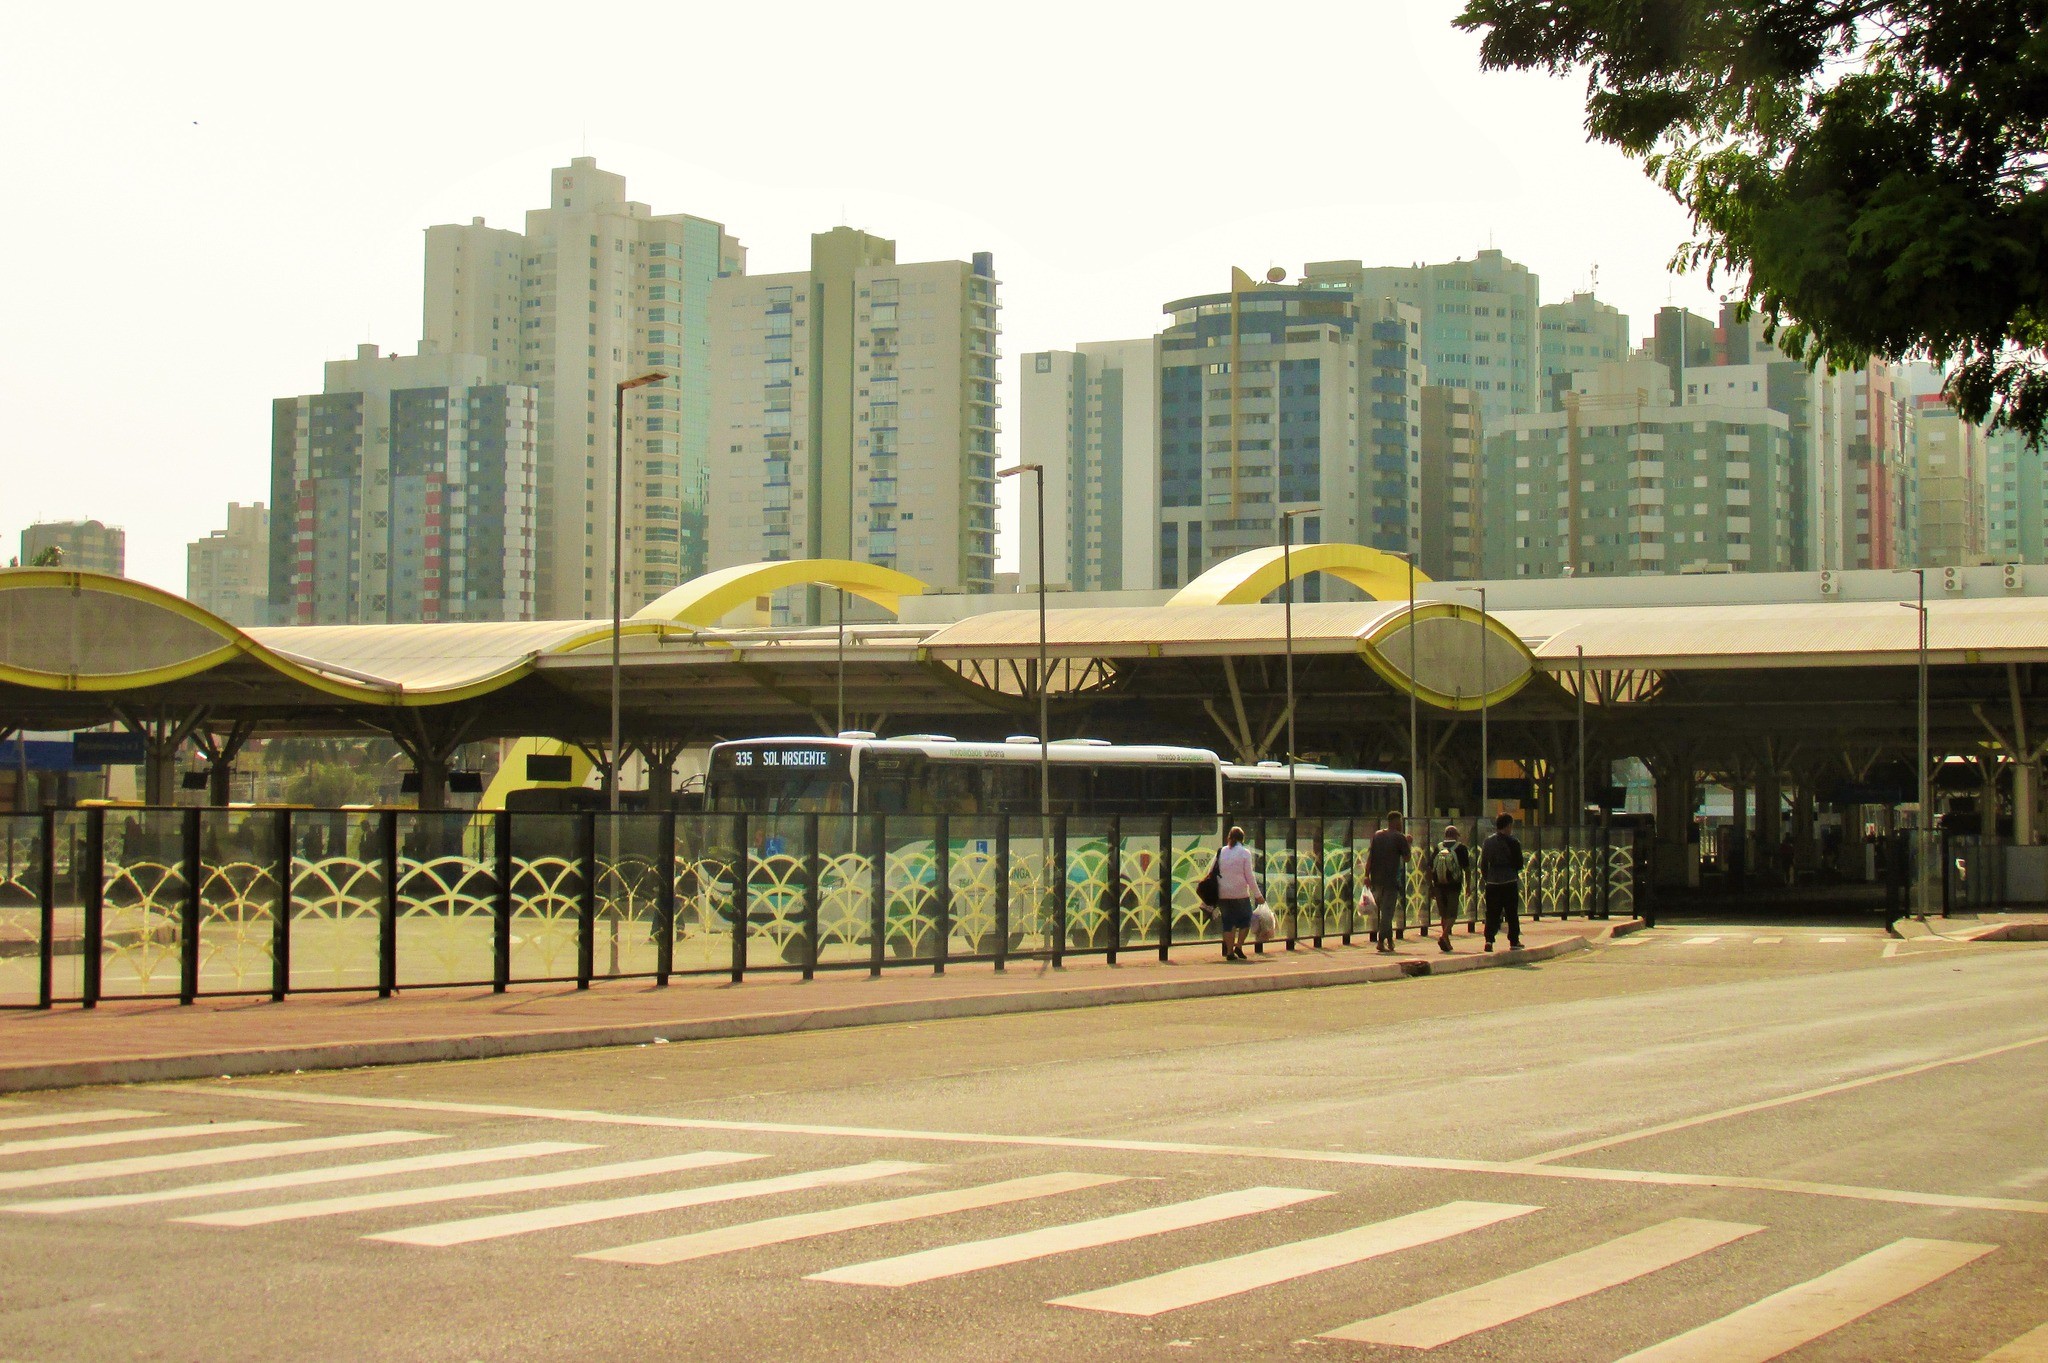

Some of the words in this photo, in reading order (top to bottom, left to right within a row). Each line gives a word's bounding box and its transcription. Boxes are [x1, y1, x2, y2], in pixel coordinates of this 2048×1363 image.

[735, 751, 753, 766] 335
[763, 751, 780, 766] SOL
[781, 751, 827, 765] NASCENTE
